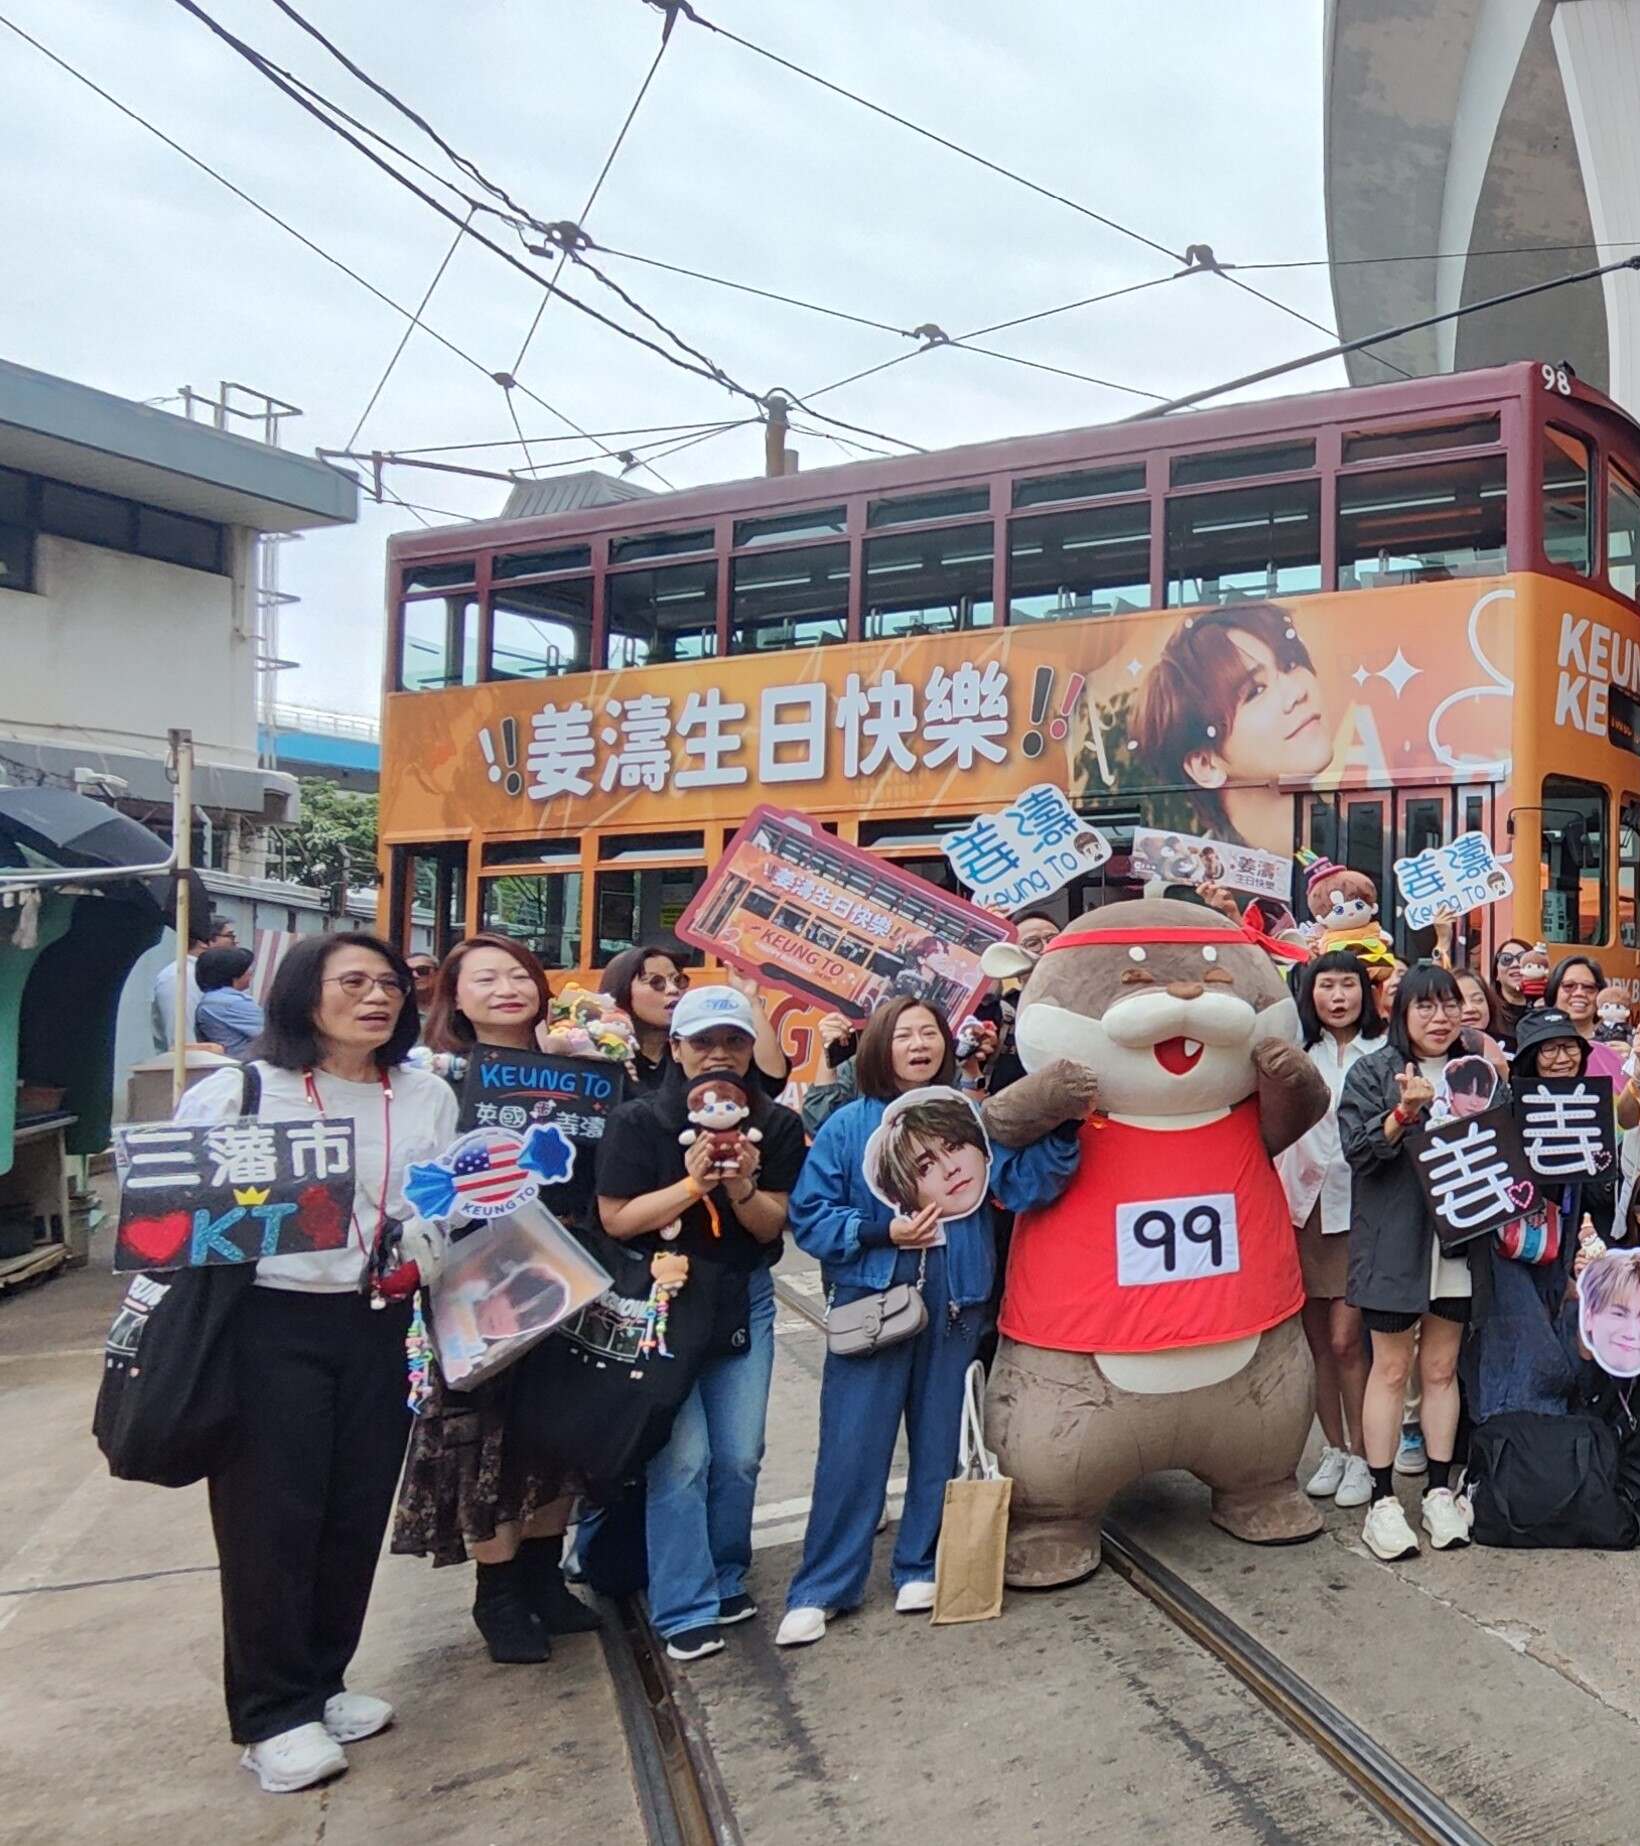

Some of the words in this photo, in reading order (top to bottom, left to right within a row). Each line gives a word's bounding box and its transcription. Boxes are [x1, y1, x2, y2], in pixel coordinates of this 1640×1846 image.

[1541, 364, 1572, 396] 98
[760, 926, 819, 966] KEUNG
[820, 954, 846, 979] TO
[480, 1063, 576, 1092] KEUNG
[581, 1071, 612, 1098] TO
[475, 1101, 527, 1127] 英國
[125, 1121, 351, 1188] 三藩市
[462, 1200, 518, 1217] KEUNG
[519, 1186, 537, 1203] TO
[190, 1202, 299, 1266] KT
[1133, 1205, 1223, 1272] 99
